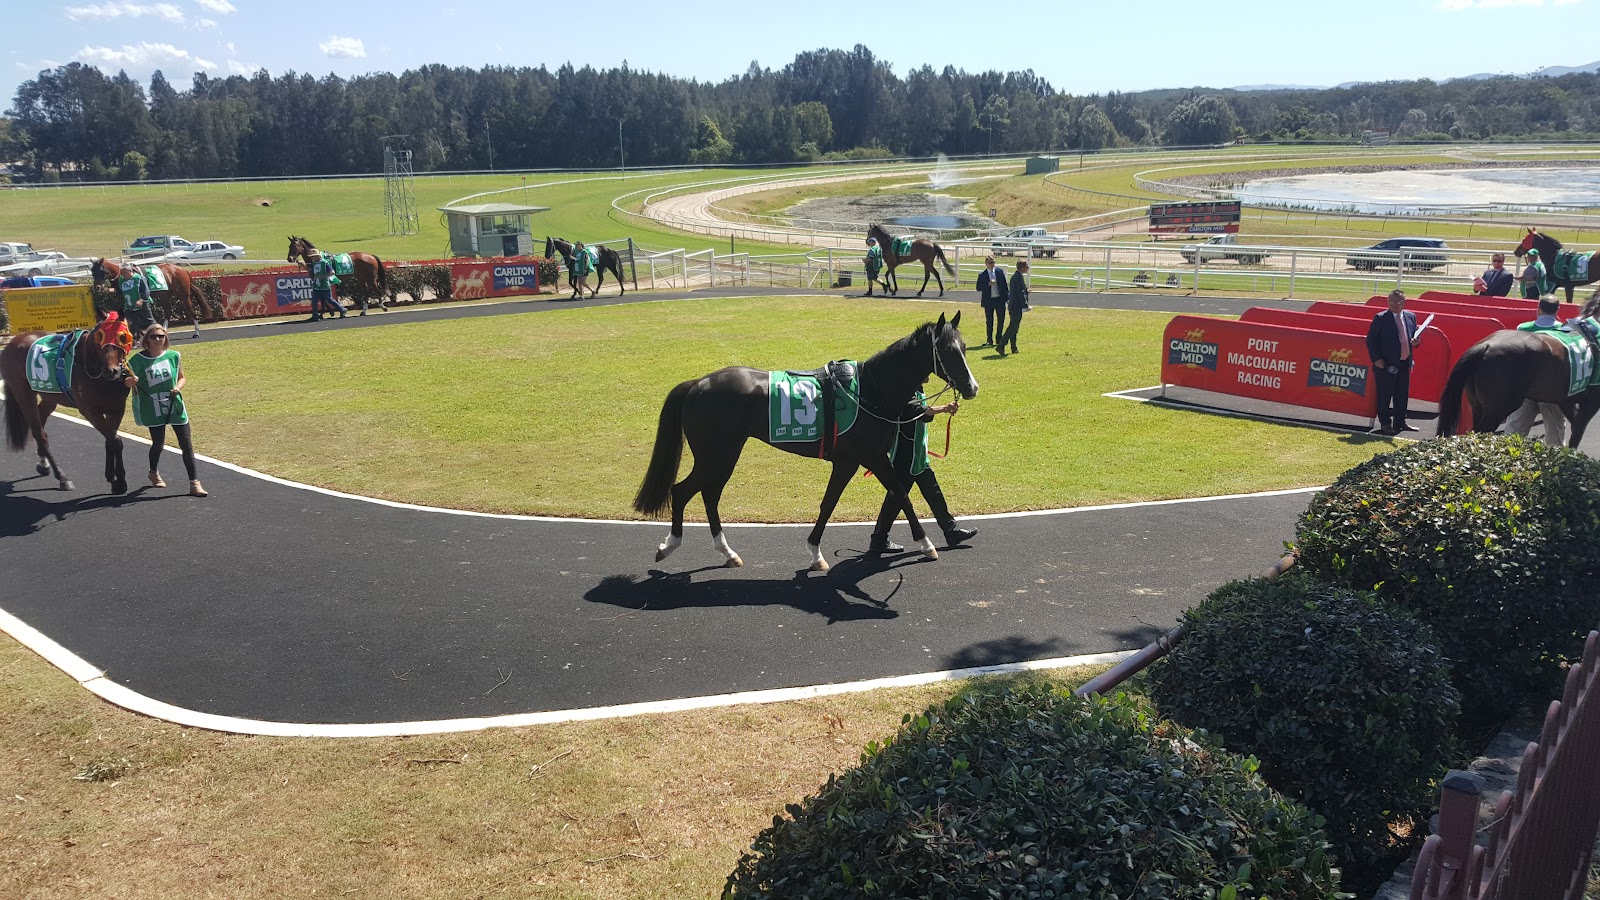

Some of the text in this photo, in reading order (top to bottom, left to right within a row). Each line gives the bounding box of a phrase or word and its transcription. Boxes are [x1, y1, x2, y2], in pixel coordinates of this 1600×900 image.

[494, 266, 535, 277] CARLTON
[276, 278, 313, 290] CARLT
[505, 276, 525, 287] MID
[1170, 339, 1217, 356] CARLTON
[1247, 338, 1278, 353] PORT
[1180, 352, 1204, 364] MID
[1227, 352, 1296, 374] MACQUARIE
[149, 367, 170, 380] TAB
[1310, 360, 1366, 379] CARLTON
[1237, 371, 1281, 389] RACING
[1322, 373, 1350, 387] MID
[150, 391, 173, 417] 15
[775, 380, 818, 425] 13
